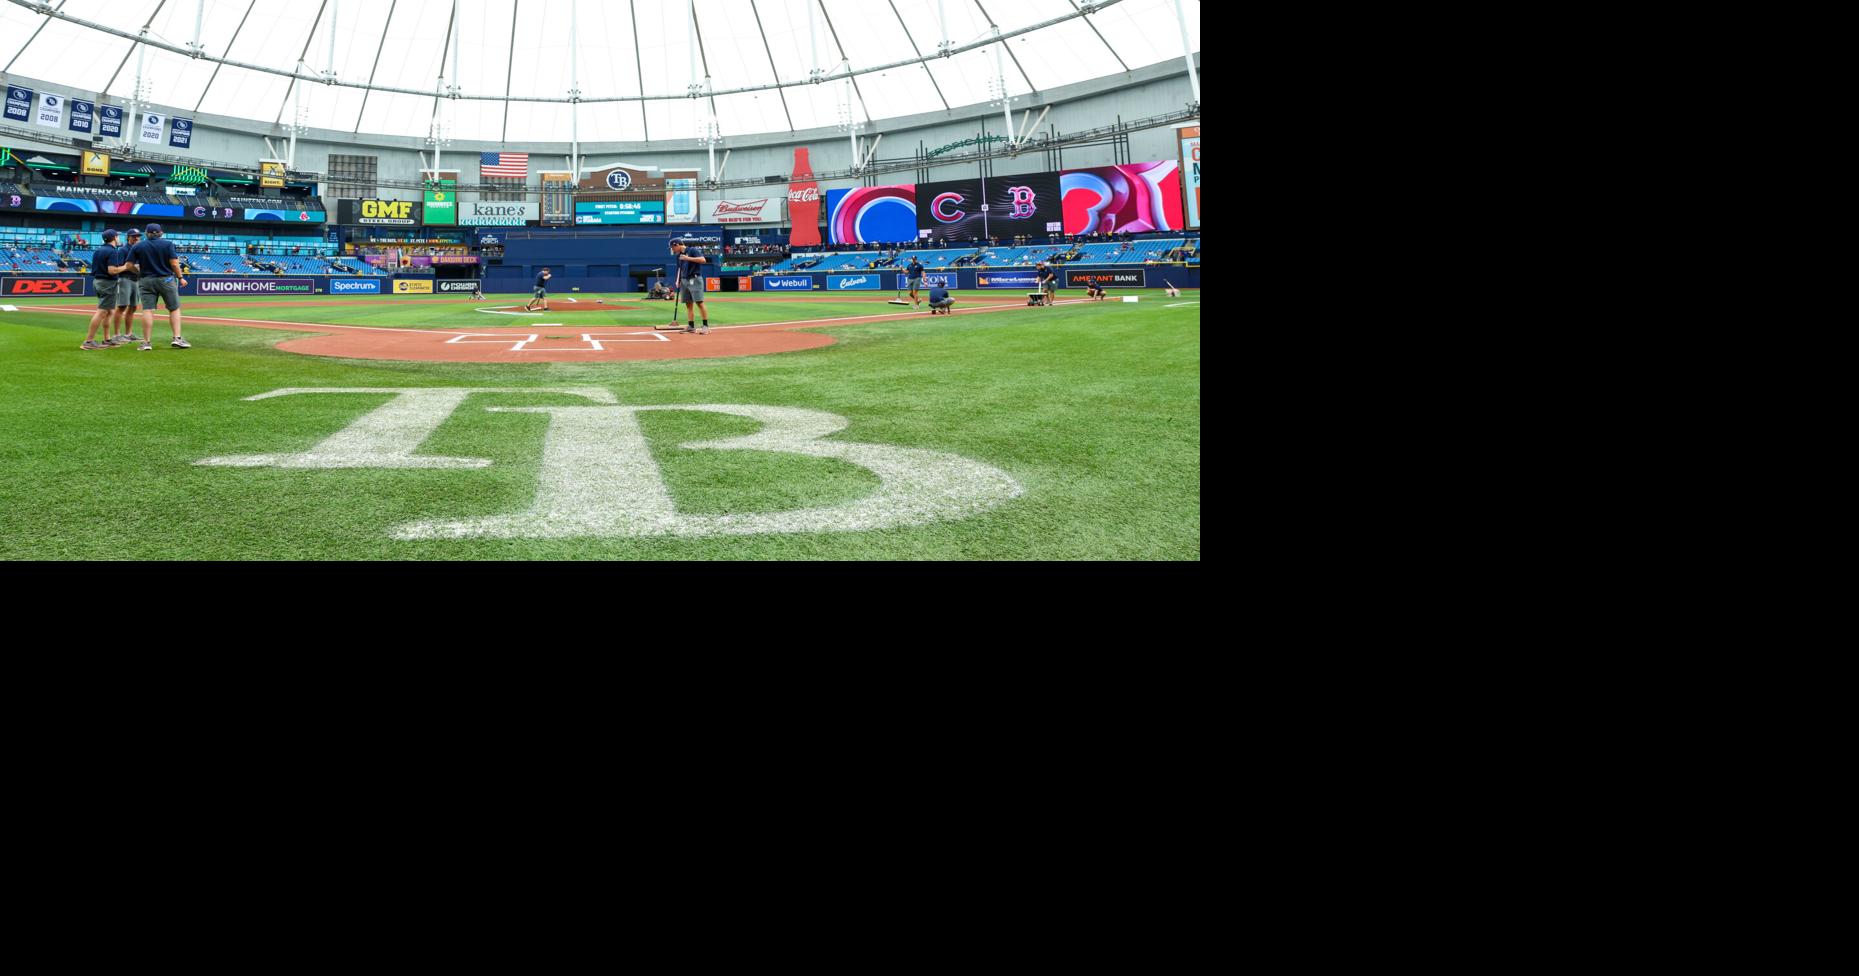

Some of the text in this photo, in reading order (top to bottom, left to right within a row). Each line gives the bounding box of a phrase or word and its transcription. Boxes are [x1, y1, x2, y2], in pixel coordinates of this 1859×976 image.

[7, 106, 27, 116] 2008
[40, 113, 59, 122] 2008
[72, 119, 89, 128] 2010
[102, 124, 119, 133] 2020
[142, 131, 159, 139] 2020
[173, 136, 188, 144] 2021
[610, 173, 627, 188] TB
[56, 185, 138, 197] MAINTENX.COM
[362, 200, 413, 218] GMF
[473, 203, 526, 216] kane's
[719, 203, 763, 213] Budweiser
[12, 280, 75, 293] DEX
[334, 281, 373, 291] Spectrum
[781, 279, 808, 287] Webull
[840, 276, 867, 288] Culver's
[193, 386, 1024, 540] TB
